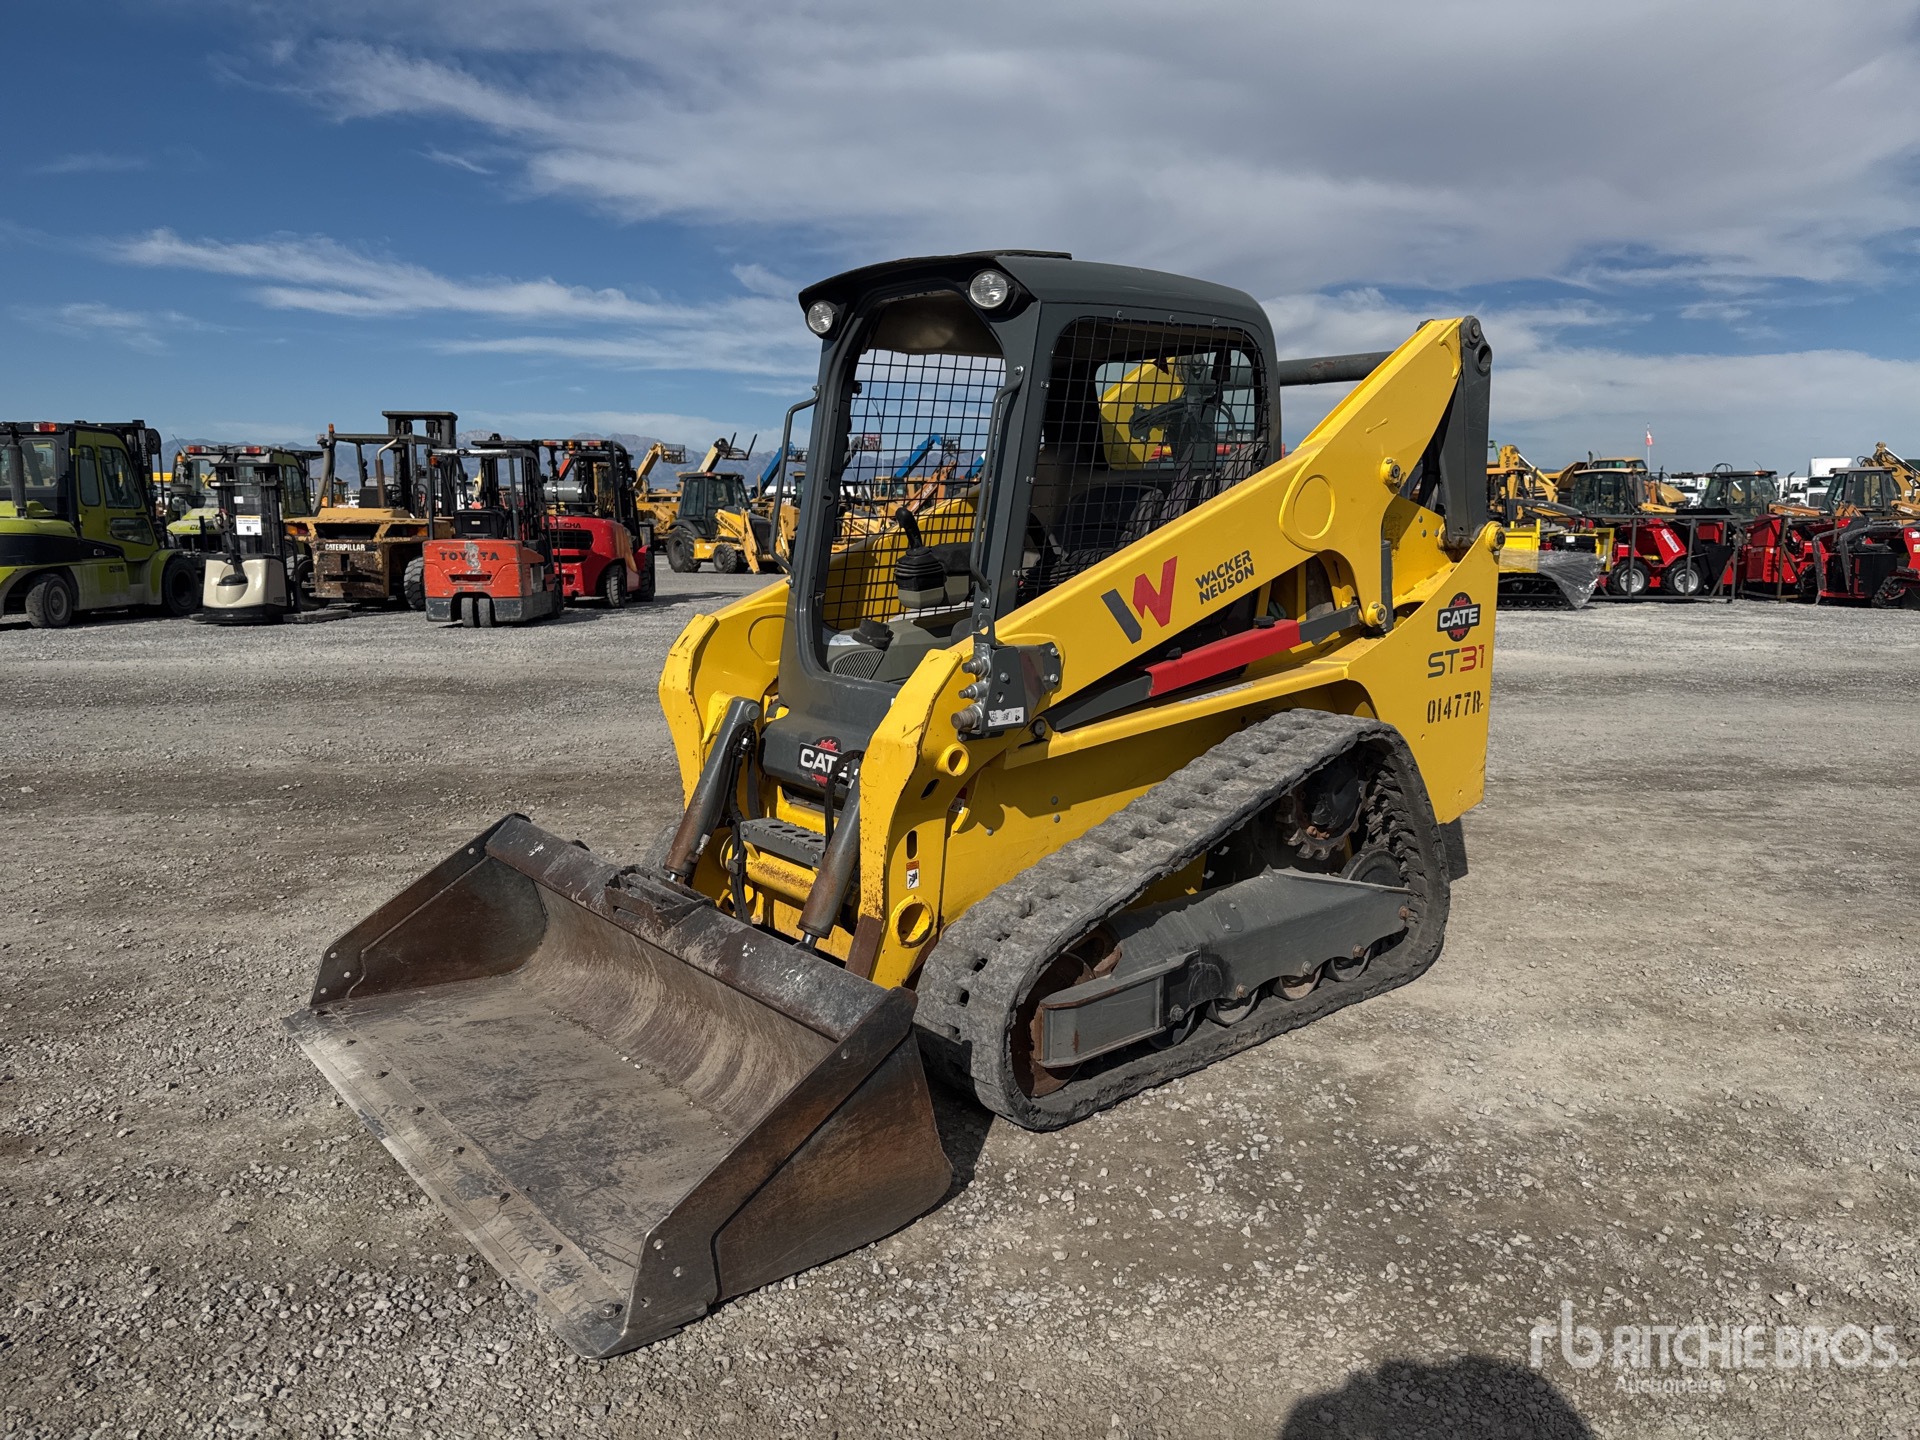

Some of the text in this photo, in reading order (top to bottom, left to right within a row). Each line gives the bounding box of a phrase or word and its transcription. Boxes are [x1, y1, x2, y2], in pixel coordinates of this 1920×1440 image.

[325, 543, 366, 552] CATERPILLAR
[439, 551, 500, 561] TOYTA
[1195, 550, 1252, 589] WACKER
[1198, 562, 1255, 605] NEUSON
[1439, 607, 1479, 628] CATE
[1427, 644, 1485, 679] ST31
[1427, 690, 1482, 724] 01477R
